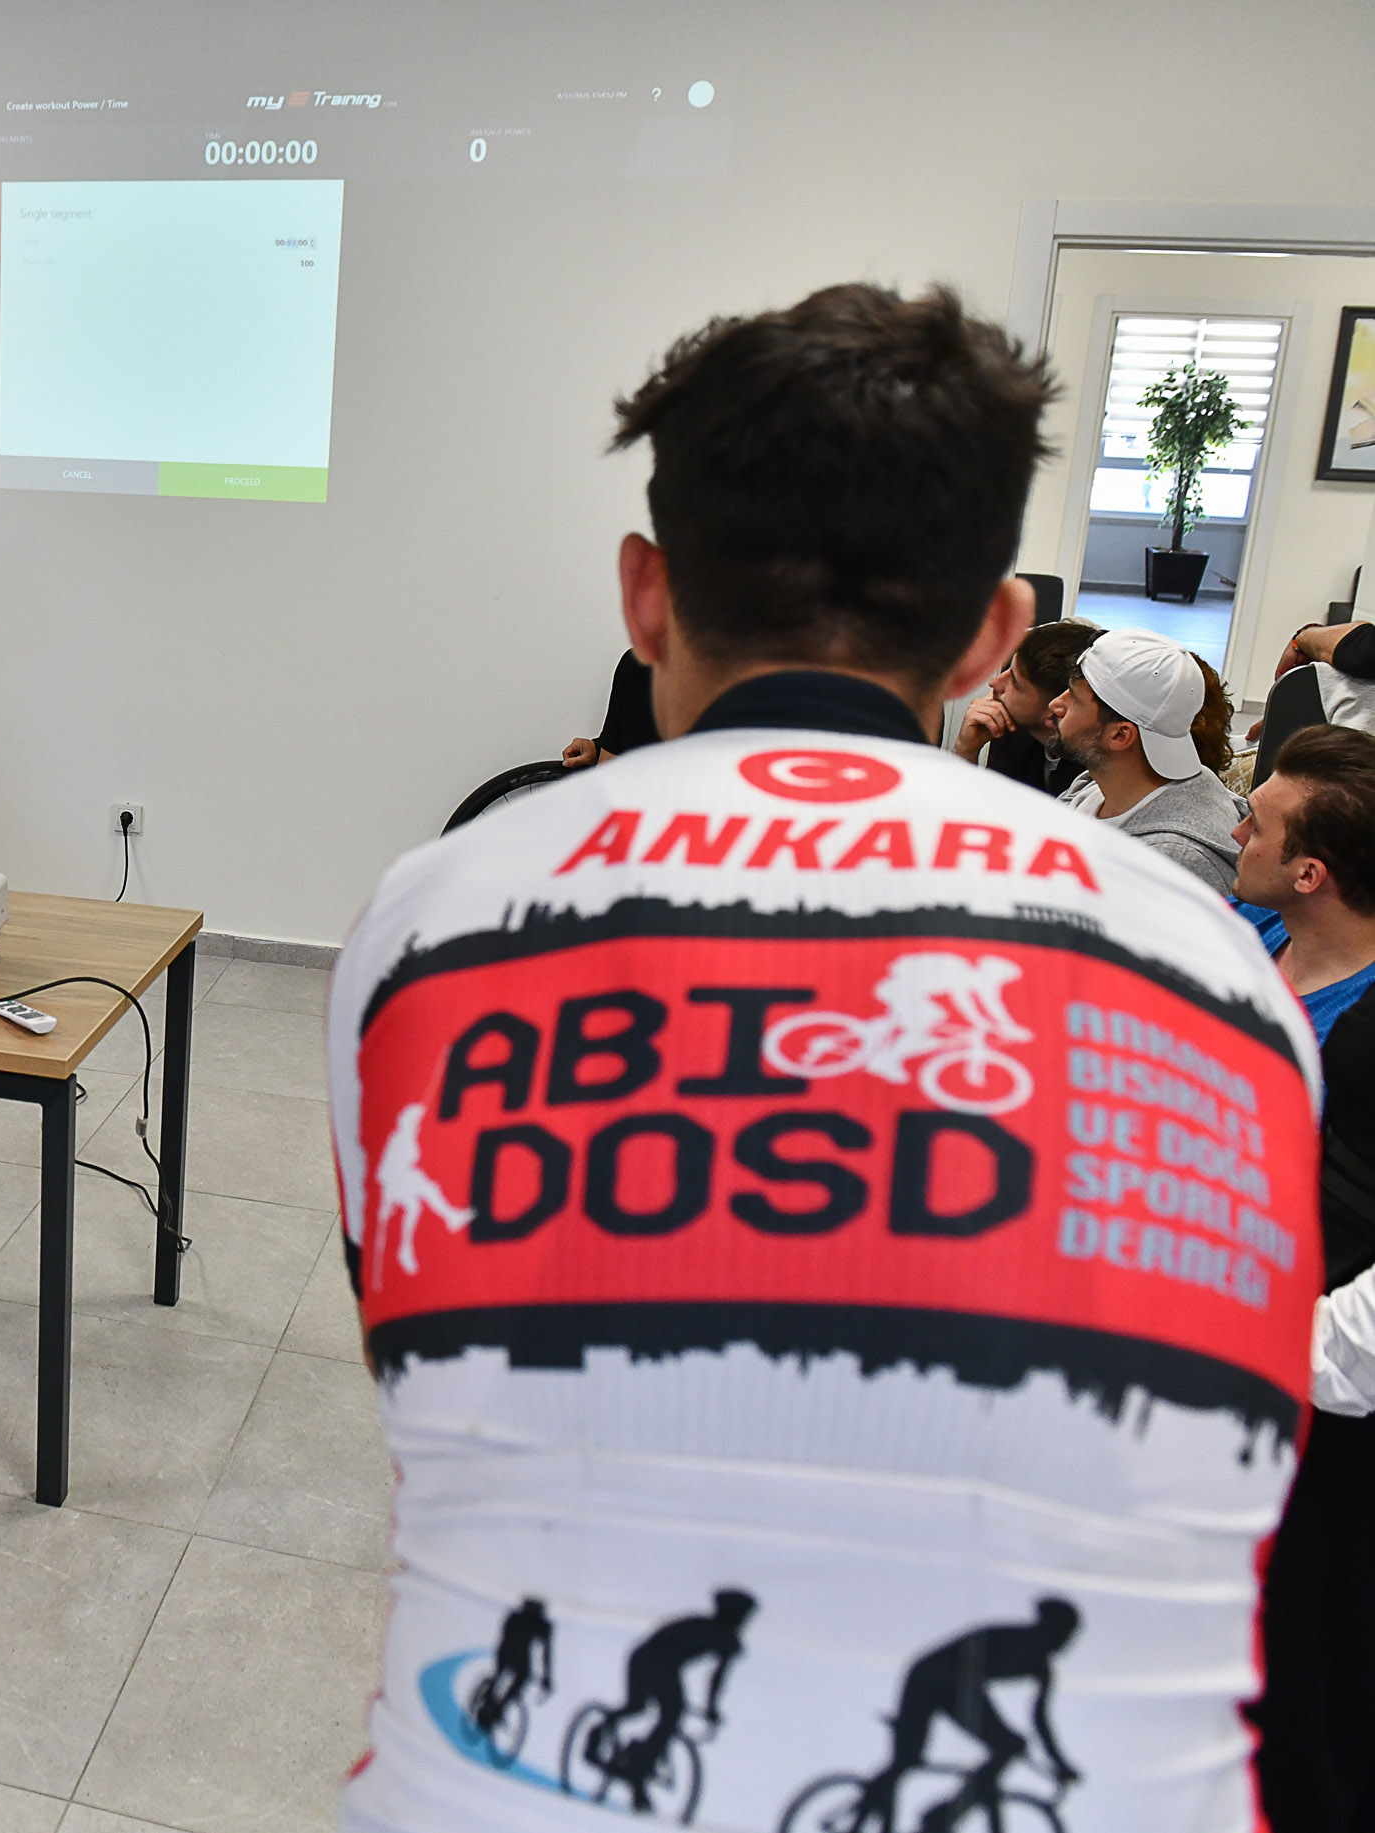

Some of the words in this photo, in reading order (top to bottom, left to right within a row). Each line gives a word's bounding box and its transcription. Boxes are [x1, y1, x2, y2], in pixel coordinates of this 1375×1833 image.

[246, 95, 285, 110] my
[312, 91, 383, 109] Training
[651, 87, 662, 102] ?
[6, 101, 34, 111] Create
[35, 101, 71, 111] workout
[72, 100, 98, 110] Power
[107, 99, 129, 109] Time
[204, 139, 318, 165] 00:00:00
[469, 138, 487, 163] 0
[19, 208, 49, 222] Single
[50, 209, 92, 221] segment
[300, 259, 314, 267] 100
[61, 469, 93, 480] CANCEL
[224, 476, 261, 487] PROCEED
[551, 809, 1103, 895] ANKARA
[436, 987, 818, 1123] ABI
[468, 1109, 1036, 1245] DOSD
